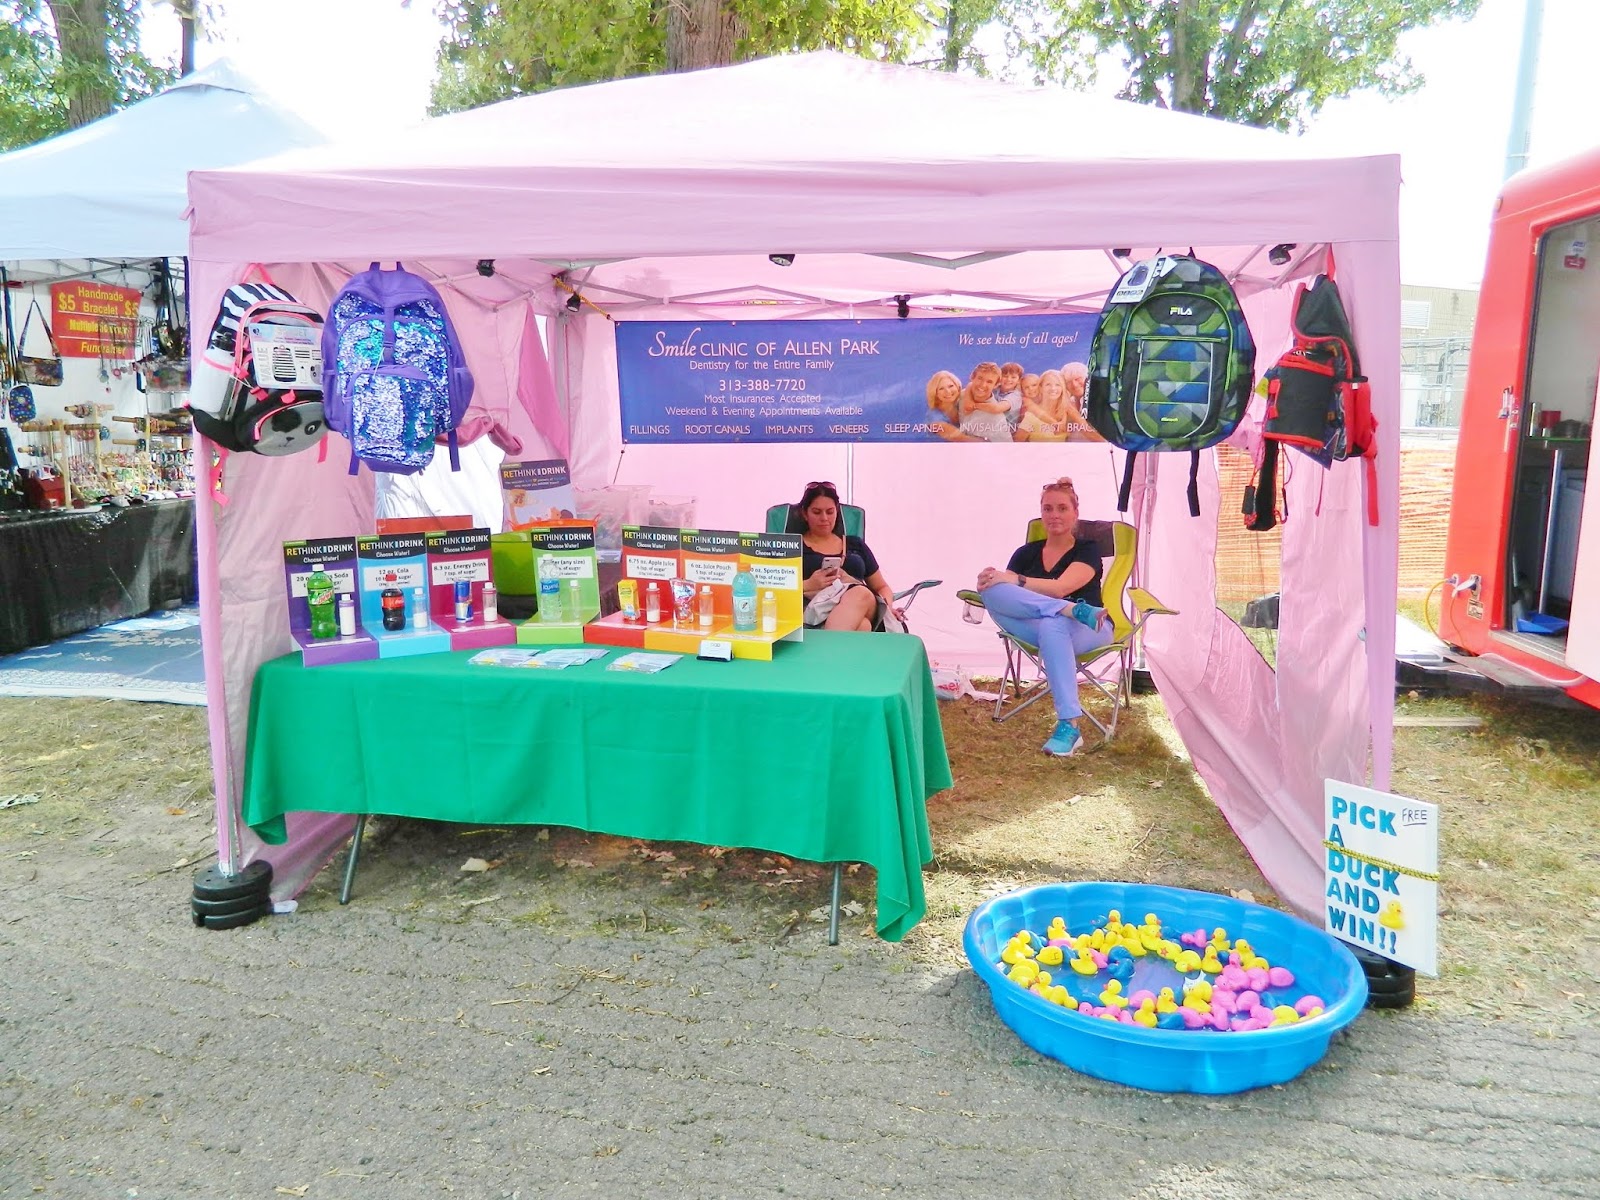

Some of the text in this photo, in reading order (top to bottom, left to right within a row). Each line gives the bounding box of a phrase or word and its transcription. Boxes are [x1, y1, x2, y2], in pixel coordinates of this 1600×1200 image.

[77, 286, 124, 302] Handmade
[58, 292, 76, 311] $5
[82, 302, 119, 315] Bracelet
[1169, 307, 1193, 316] FILA
[648, 327, 880, 358] Smile CLINIC OF ALLEN PARK
[959, 331, 1079, 349] We see kids of all ages!
[689, 359, 835, 372] Dentistry for the Entire Family
[719, 379, 806, 392] 313-388-7720
[704, 394, 821, 406] Most Insurances Accepted
[665, 405, 863, 418] Weekend & Evening Appointments Available
[629, 425, 670, 435] FILLINGS
[685, 424, 751, 435] ROOT CANALS
[765, 424, 814, 435] IMPLANTS
[828, 424, 870, 434] VENEERS
[884, 423, 945, 433] SLEEP APNEA
[1066, 422, 1098, 432] BRAC
[541, 466, 566, 475] DRINK
[428, 534, 489, 546] RETHINK DRINK
[533, 533, 592, 541] RETHINK DRINK
[624, 531, 678, 542] RETHINK DRINK
[682, 535, 739, 546] RETHINK DRINK
[286, 543, 354, 556] RETHINK DRINK
[360, 539, 424, 551] RETHINK DRINK
[741, 539, 800, 549] RETHINK DRINK
[1331, 795, 1397, 837] PICK
[1401, 808, 1428, 822] FREE
[1328, 823, 1345, 848] A
[1328, 847, 1401, 896] DUCK
[1326, 877, 1381, 914] AND
[1328, 905, 1398, 955] WIN!!
